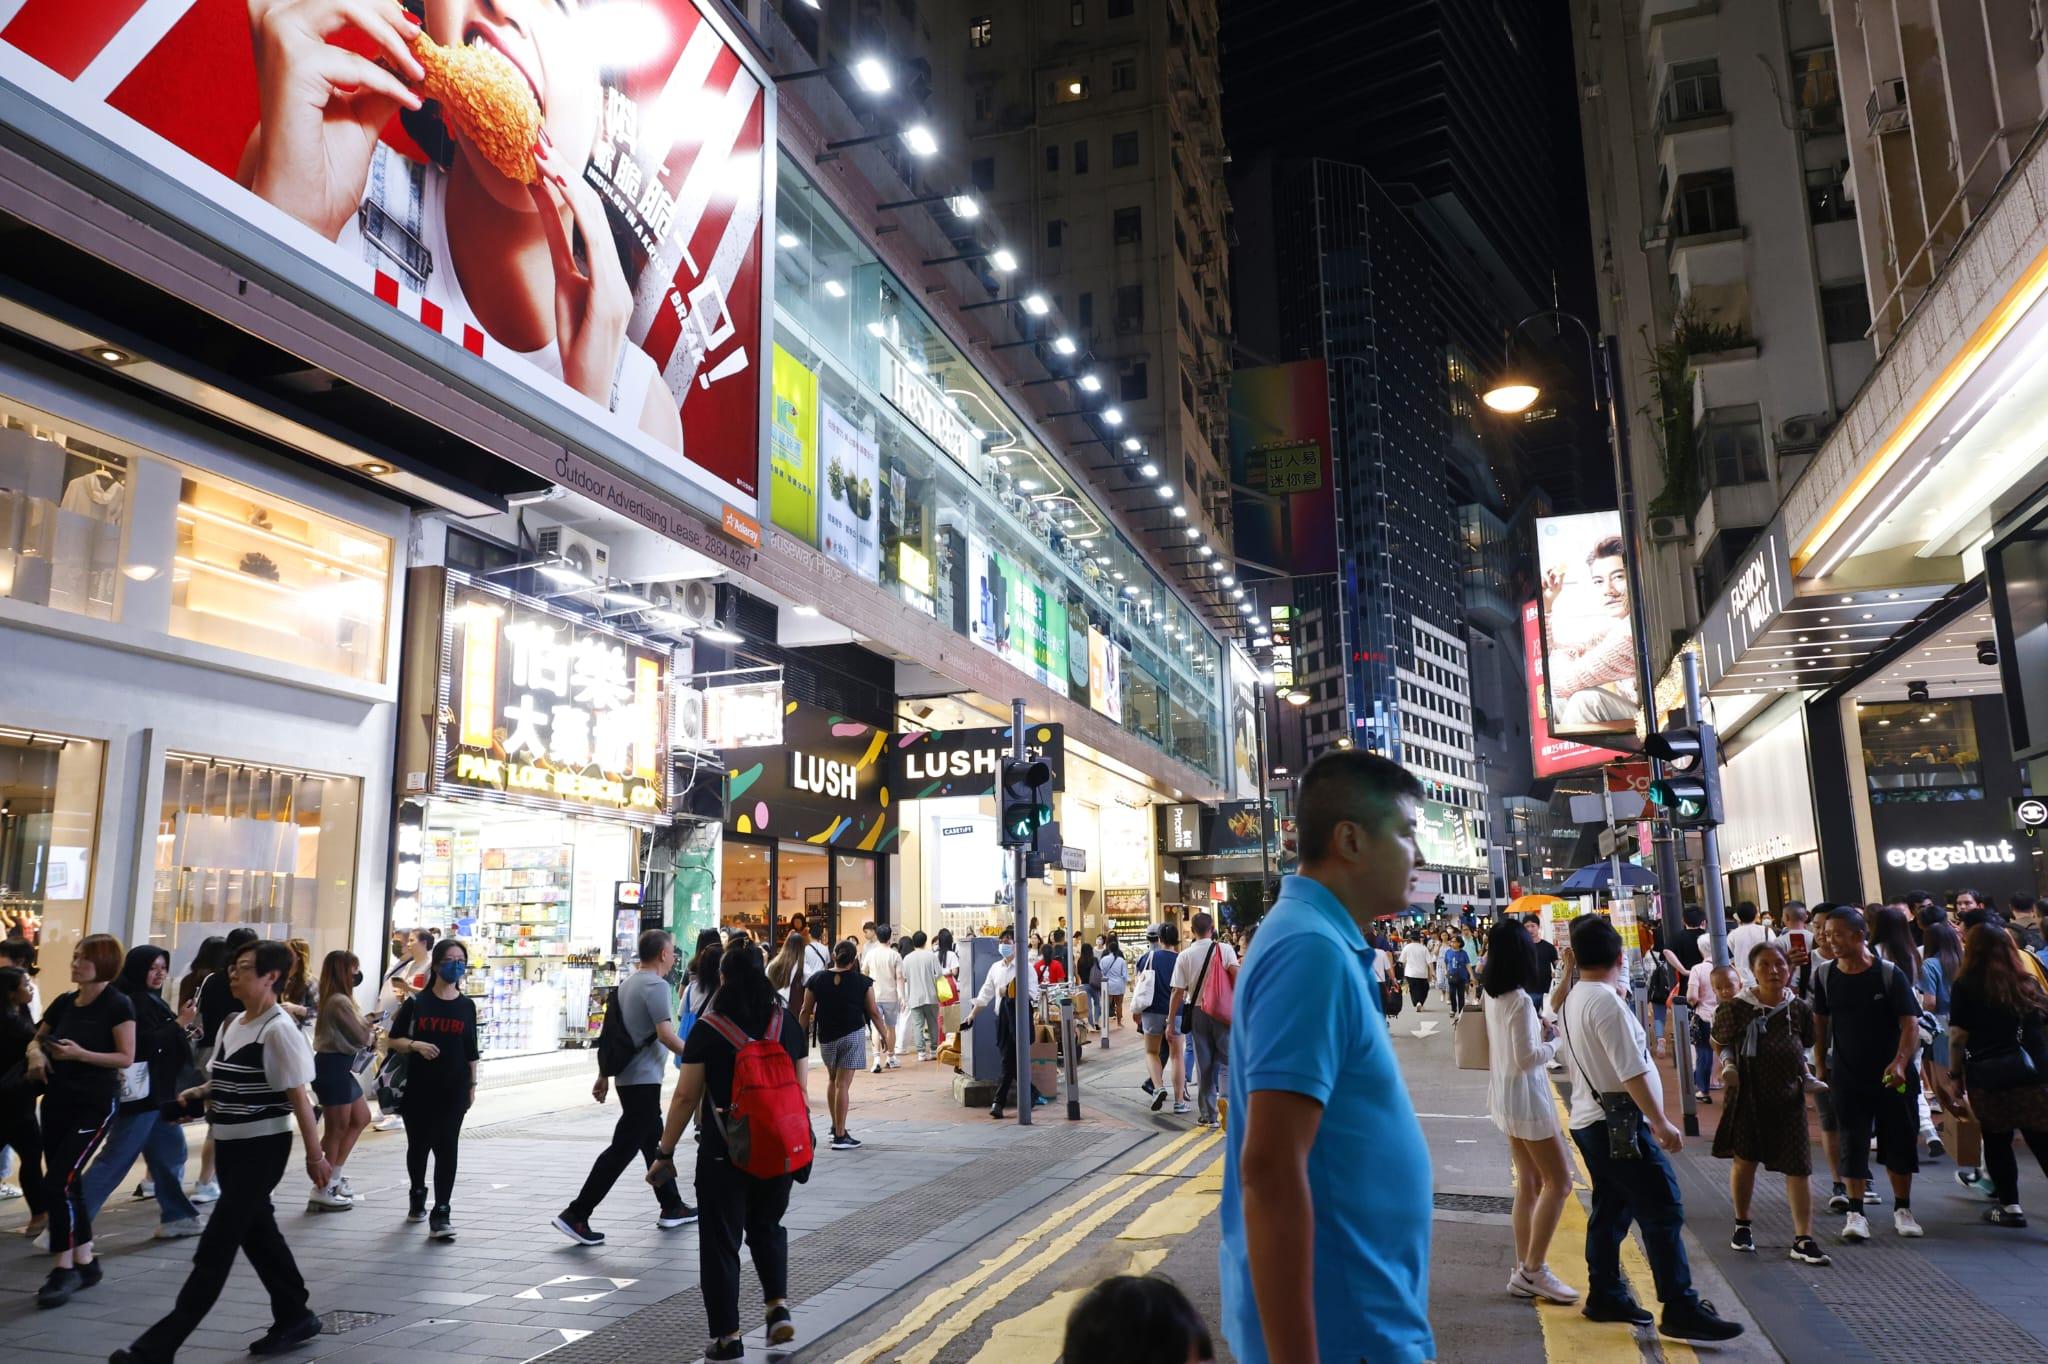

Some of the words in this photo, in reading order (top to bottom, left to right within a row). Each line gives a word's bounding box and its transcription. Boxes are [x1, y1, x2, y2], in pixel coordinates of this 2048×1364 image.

[586, 166, 628, 213] INDULGE
[623, 207, 638, 228] IN
[634, 225, 643, 239] A
[669, 290, 706, 368] BREAK
[555, 457, 606, 499] Outdoor
[607, 485, 668, 533] Advertising
[670, 515, 702, 547] Lease:
[704, 534, 728, 558] 2864
[730, 549, 751, 571] 4247
[734, 518, 758, 544] Asiaray
[769, 531, 815, 573] auseway
[816, 554, 842, 584] Place
[1730, 551, 1766, 620] FASHION
[1746, 581, 1774, 633] WALK
[457, 754, 502, 784] PAK
[507, 763, 554, 791] LOK
[793, 750, 858, 801] LUSH
[905, 748, 996, 780] LUSH
[1000, 746, 1043, 758] FSH
[1174, 807, 1184, 849] Pricerite
[1886, 838, 2016, 872] eggslut
